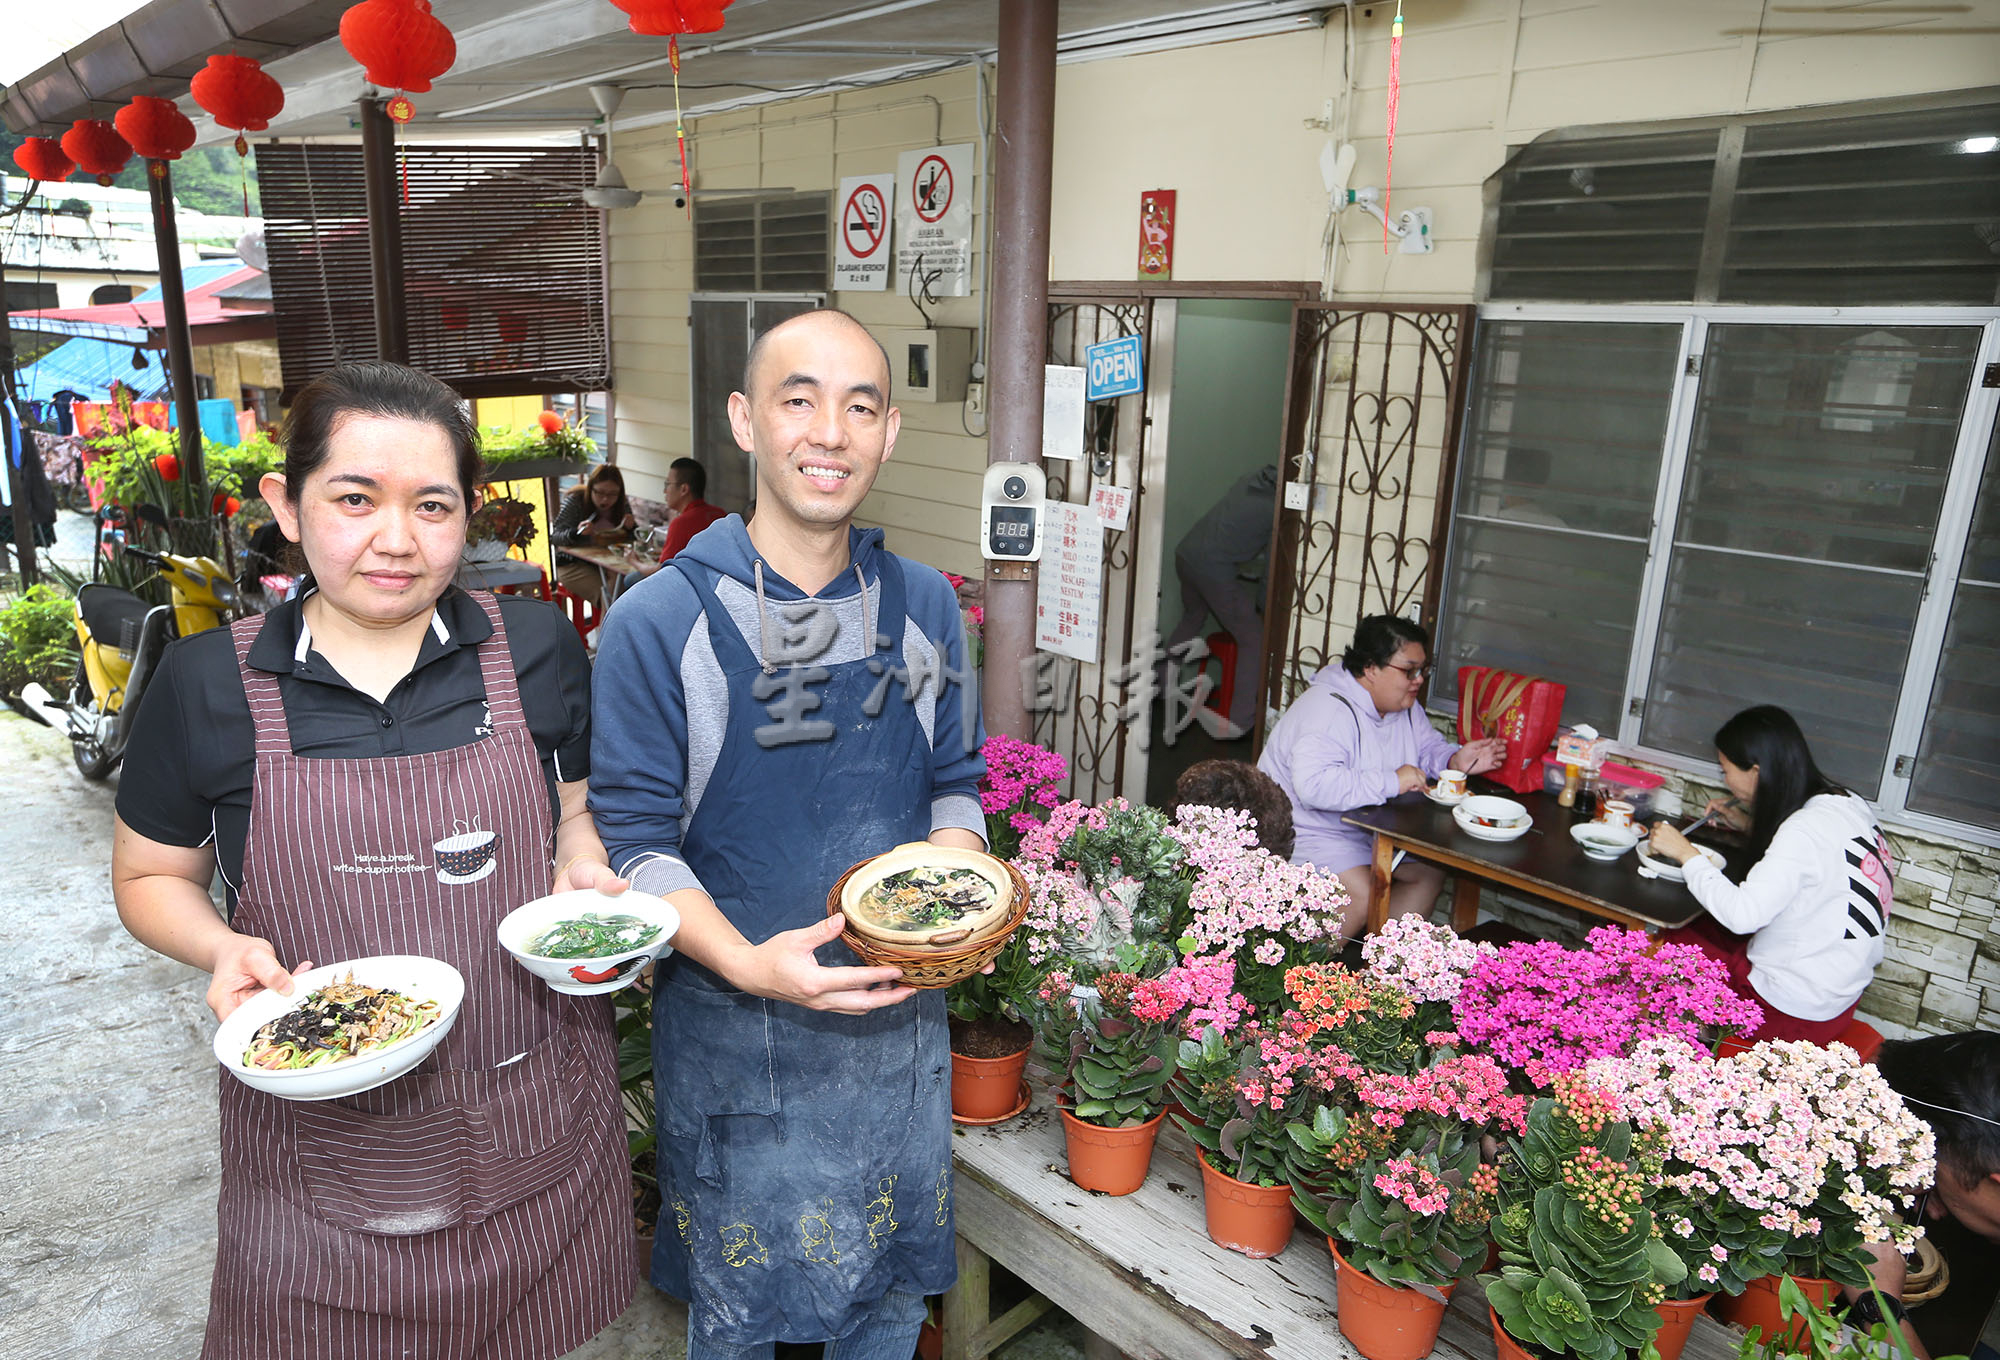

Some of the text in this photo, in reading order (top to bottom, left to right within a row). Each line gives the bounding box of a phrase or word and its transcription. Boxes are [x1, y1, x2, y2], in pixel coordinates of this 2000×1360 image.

[1092, 350, 1136, 387] OPEN
[1063, 551, 1077, 562] MILO
[1061, 562, 1076, 573] KOPI
[1061, 574, 1086, 588] NESCAFE
[1060, 586, 1084, 599] NESTUM
[1060, 598, 1072, 609] TEH
[355, 853, 378, 863] Have
[388, 853, 415, 862] break
[364, 866, 382, 875] cup
[383, 865, 394, 874] of
